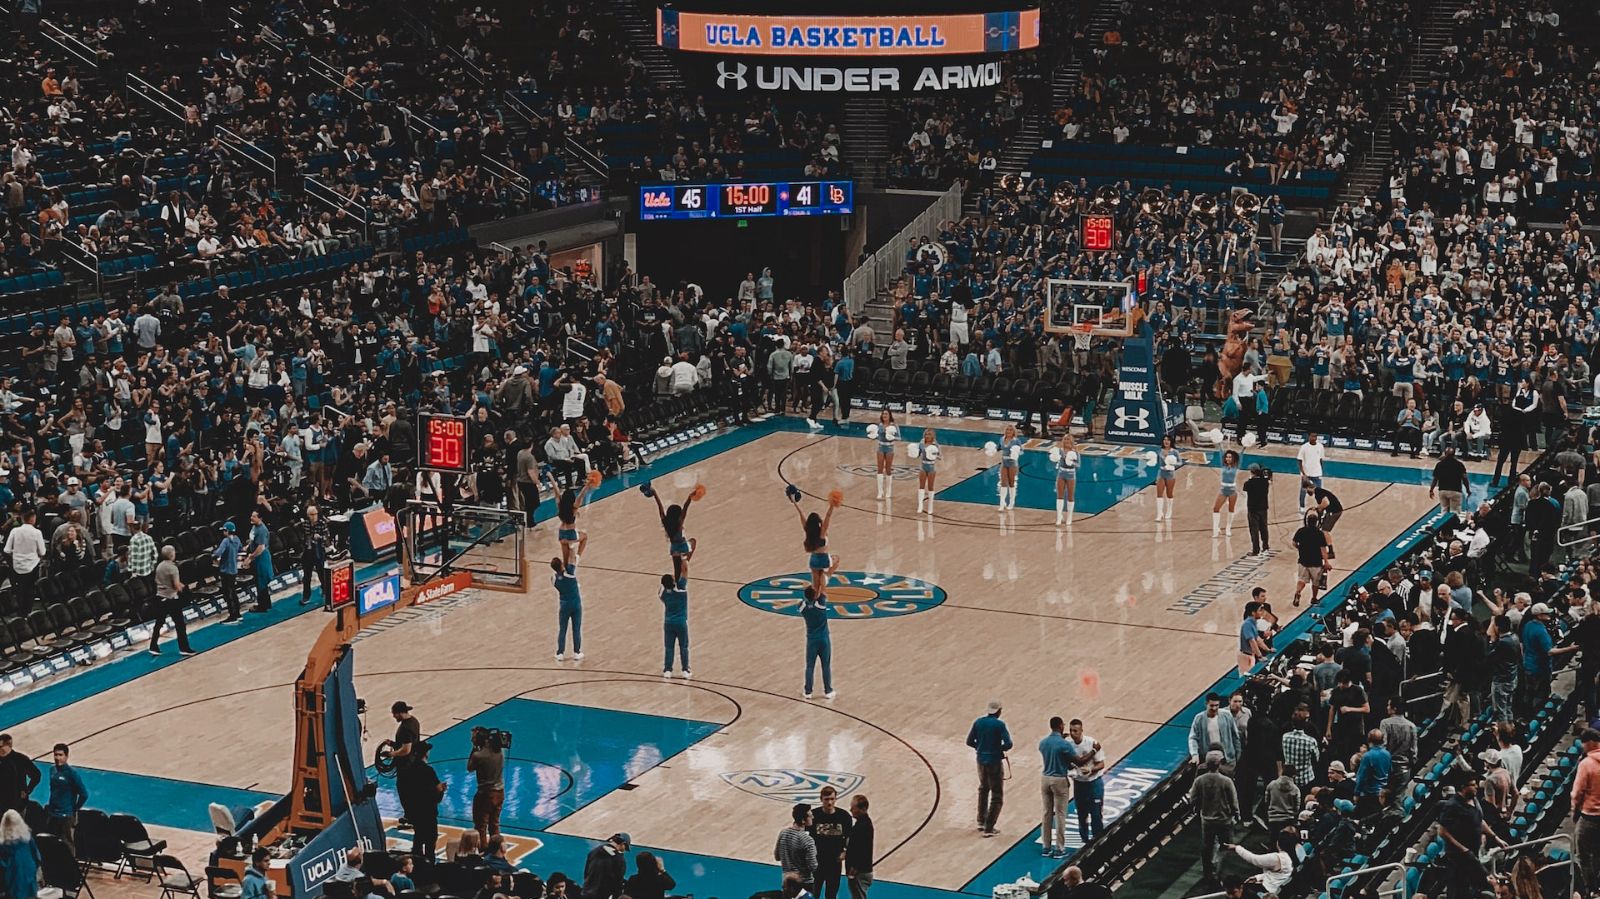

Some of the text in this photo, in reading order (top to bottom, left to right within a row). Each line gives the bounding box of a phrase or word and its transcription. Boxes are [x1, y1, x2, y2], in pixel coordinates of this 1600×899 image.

[705, 24, 945, 48] UCLA BASKETBALL
[756, 66, 900, 92] UNDER
[681, 188, 701, 209] 45
[726, 185, 769, 205] 15:00
[796, 185, 811, 205] 41
[1087, 218, 1111, 229] 15:00
[1087, 229, 1111, 247] 30
[1119, 381, 1149, 392] MUSCLE
[1124, 390, 1143, 400] MILK
[429, 419, 464, 437] 15:00
[431, 437, 460, 464] 30
[307, 858, 333, 882] UCLA
